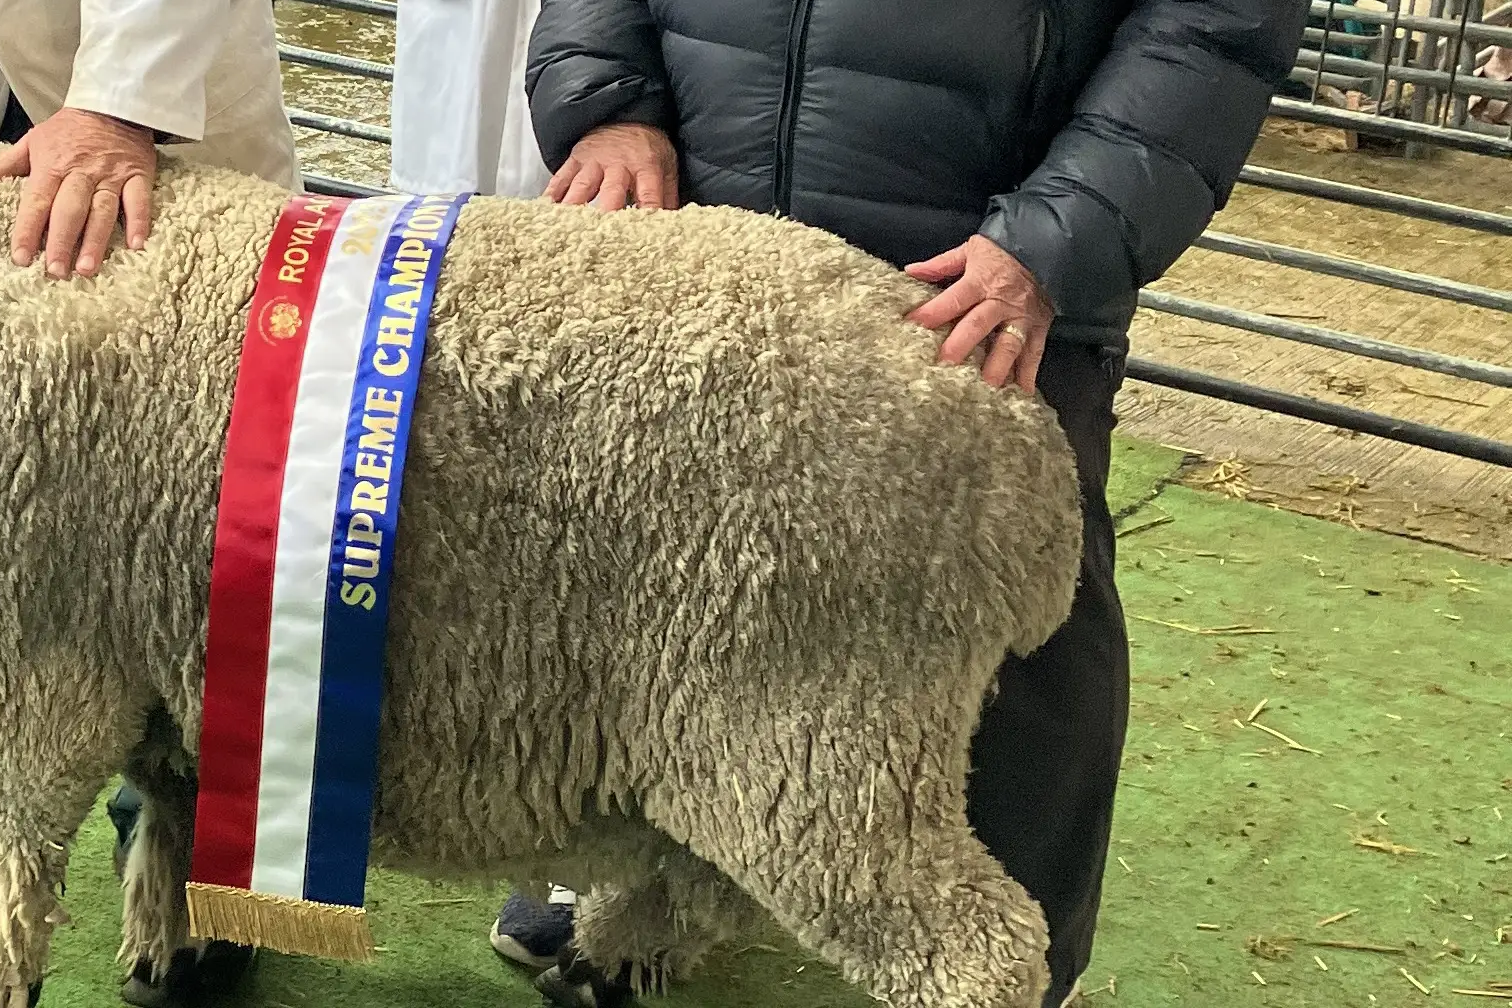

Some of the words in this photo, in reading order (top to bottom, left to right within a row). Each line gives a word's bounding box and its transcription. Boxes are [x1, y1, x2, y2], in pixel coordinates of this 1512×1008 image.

[278, 220, 322, 283] ROYAL
[340, 387, 403, 610] SUPREME
[374, 205, 451, 377] CHAMPION
